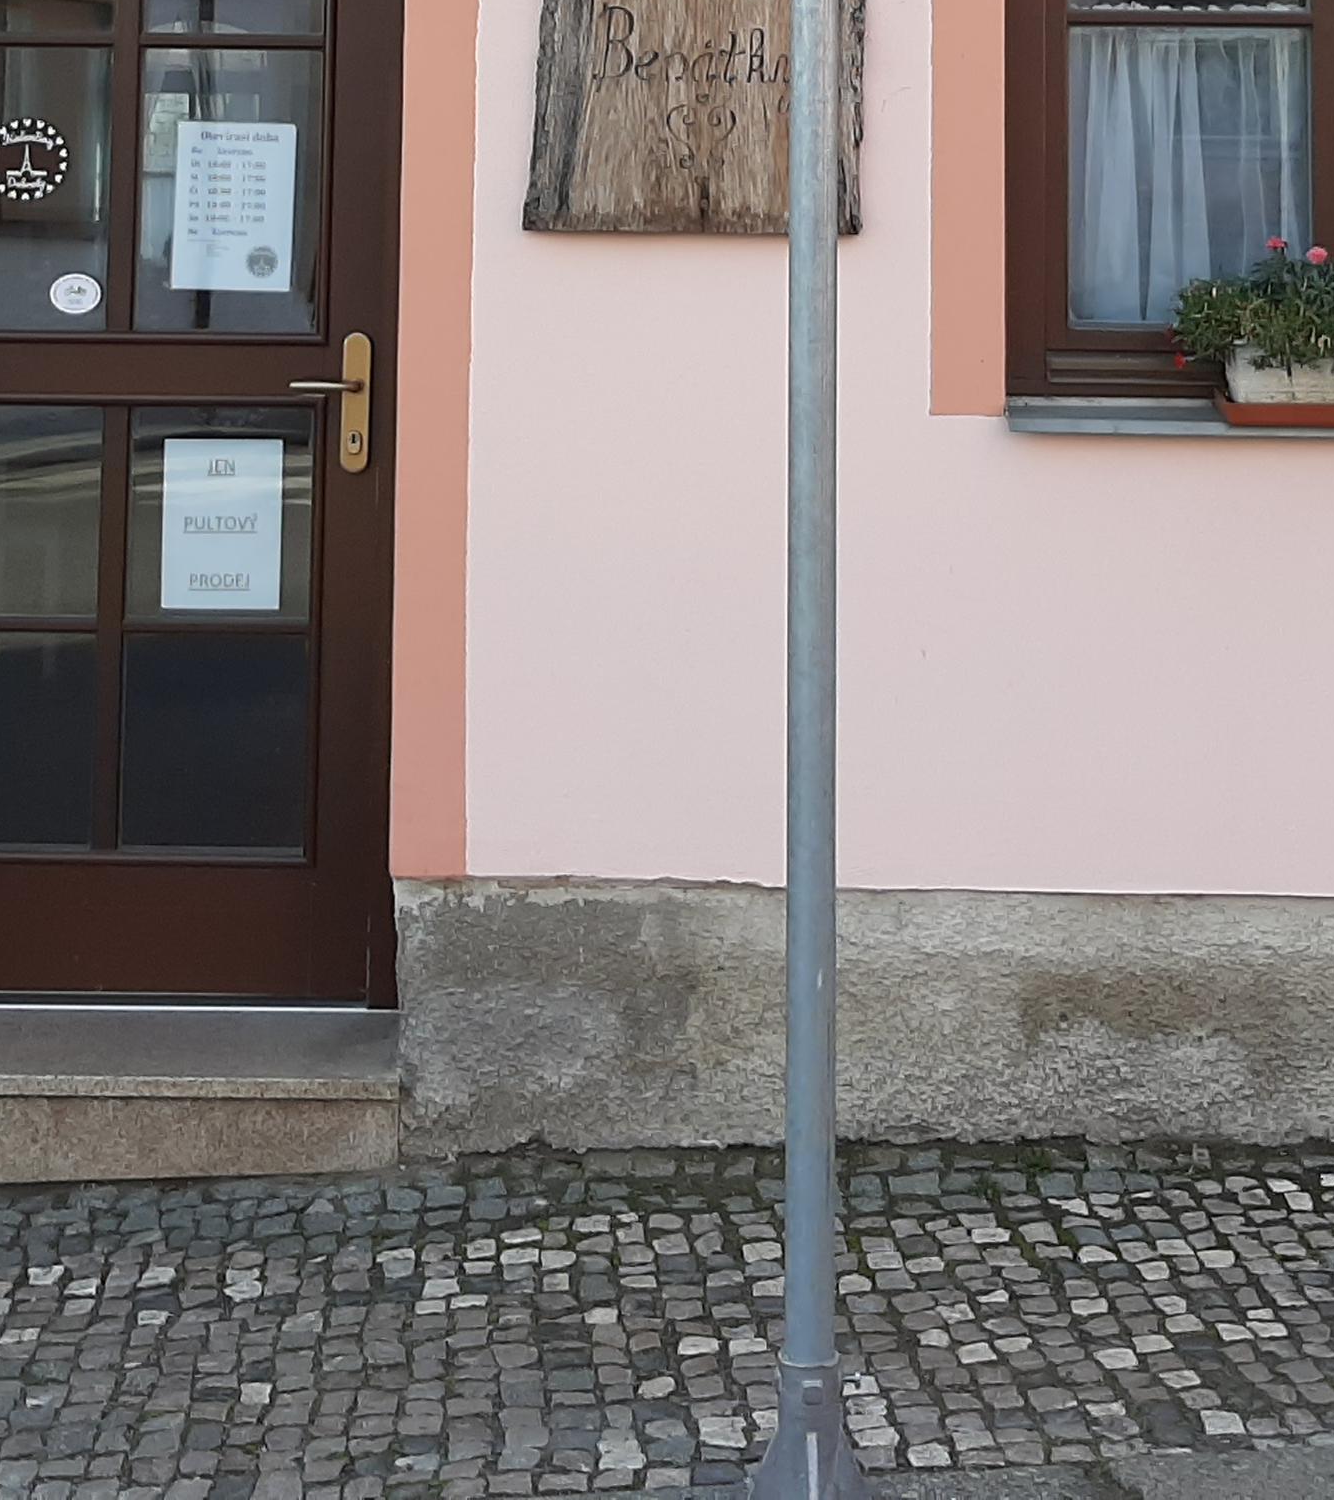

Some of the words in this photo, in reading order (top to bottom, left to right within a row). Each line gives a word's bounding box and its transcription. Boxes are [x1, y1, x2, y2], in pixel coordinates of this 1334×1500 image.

[208, 459, 236, 475] JEN
[183, 513, 258, 531] PULTOVÝ
[189, 573, 251, 589] PRODEJ
